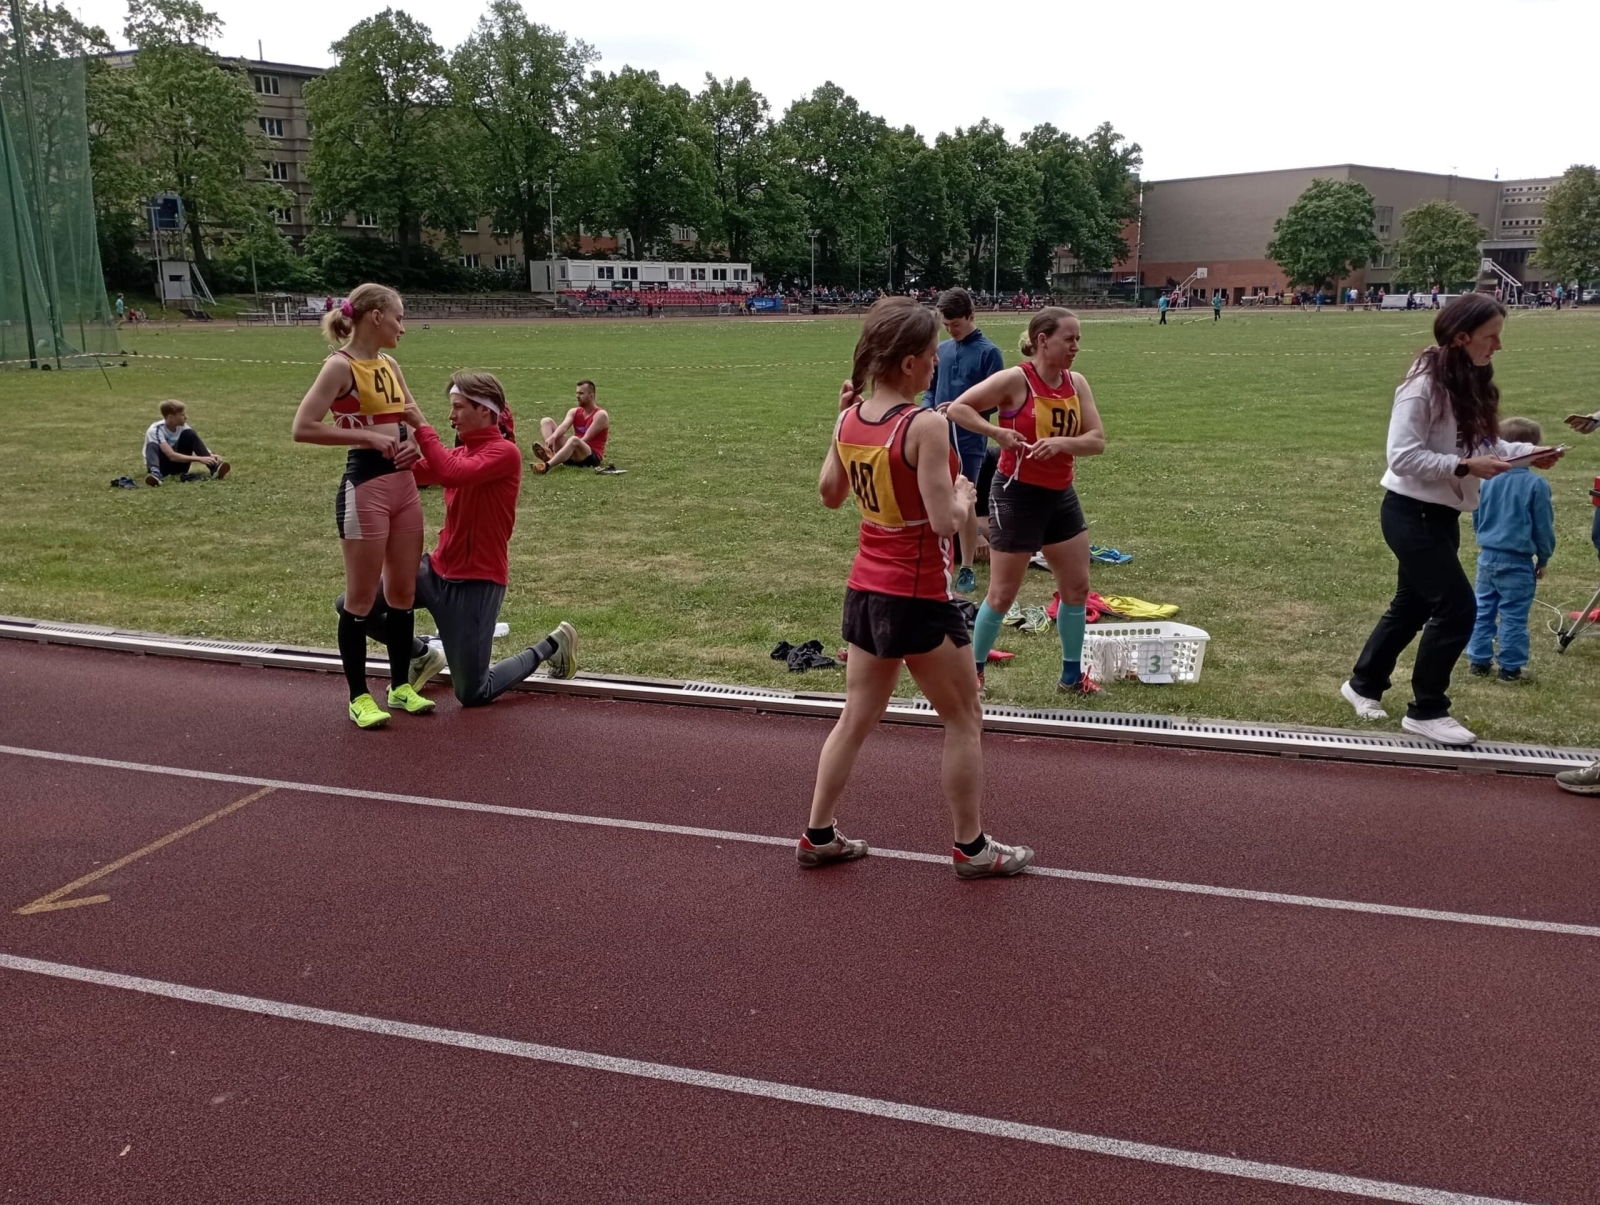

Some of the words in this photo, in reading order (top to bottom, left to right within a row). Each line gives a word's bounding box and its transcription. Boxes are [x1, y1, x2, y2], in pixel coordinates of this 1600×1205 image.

[374, 367, 401, 404] 42
[1050, 408, 1078, 437] 90
[850, 460, 880, 513] 40
[1148, 655, 1161, 674] 3
